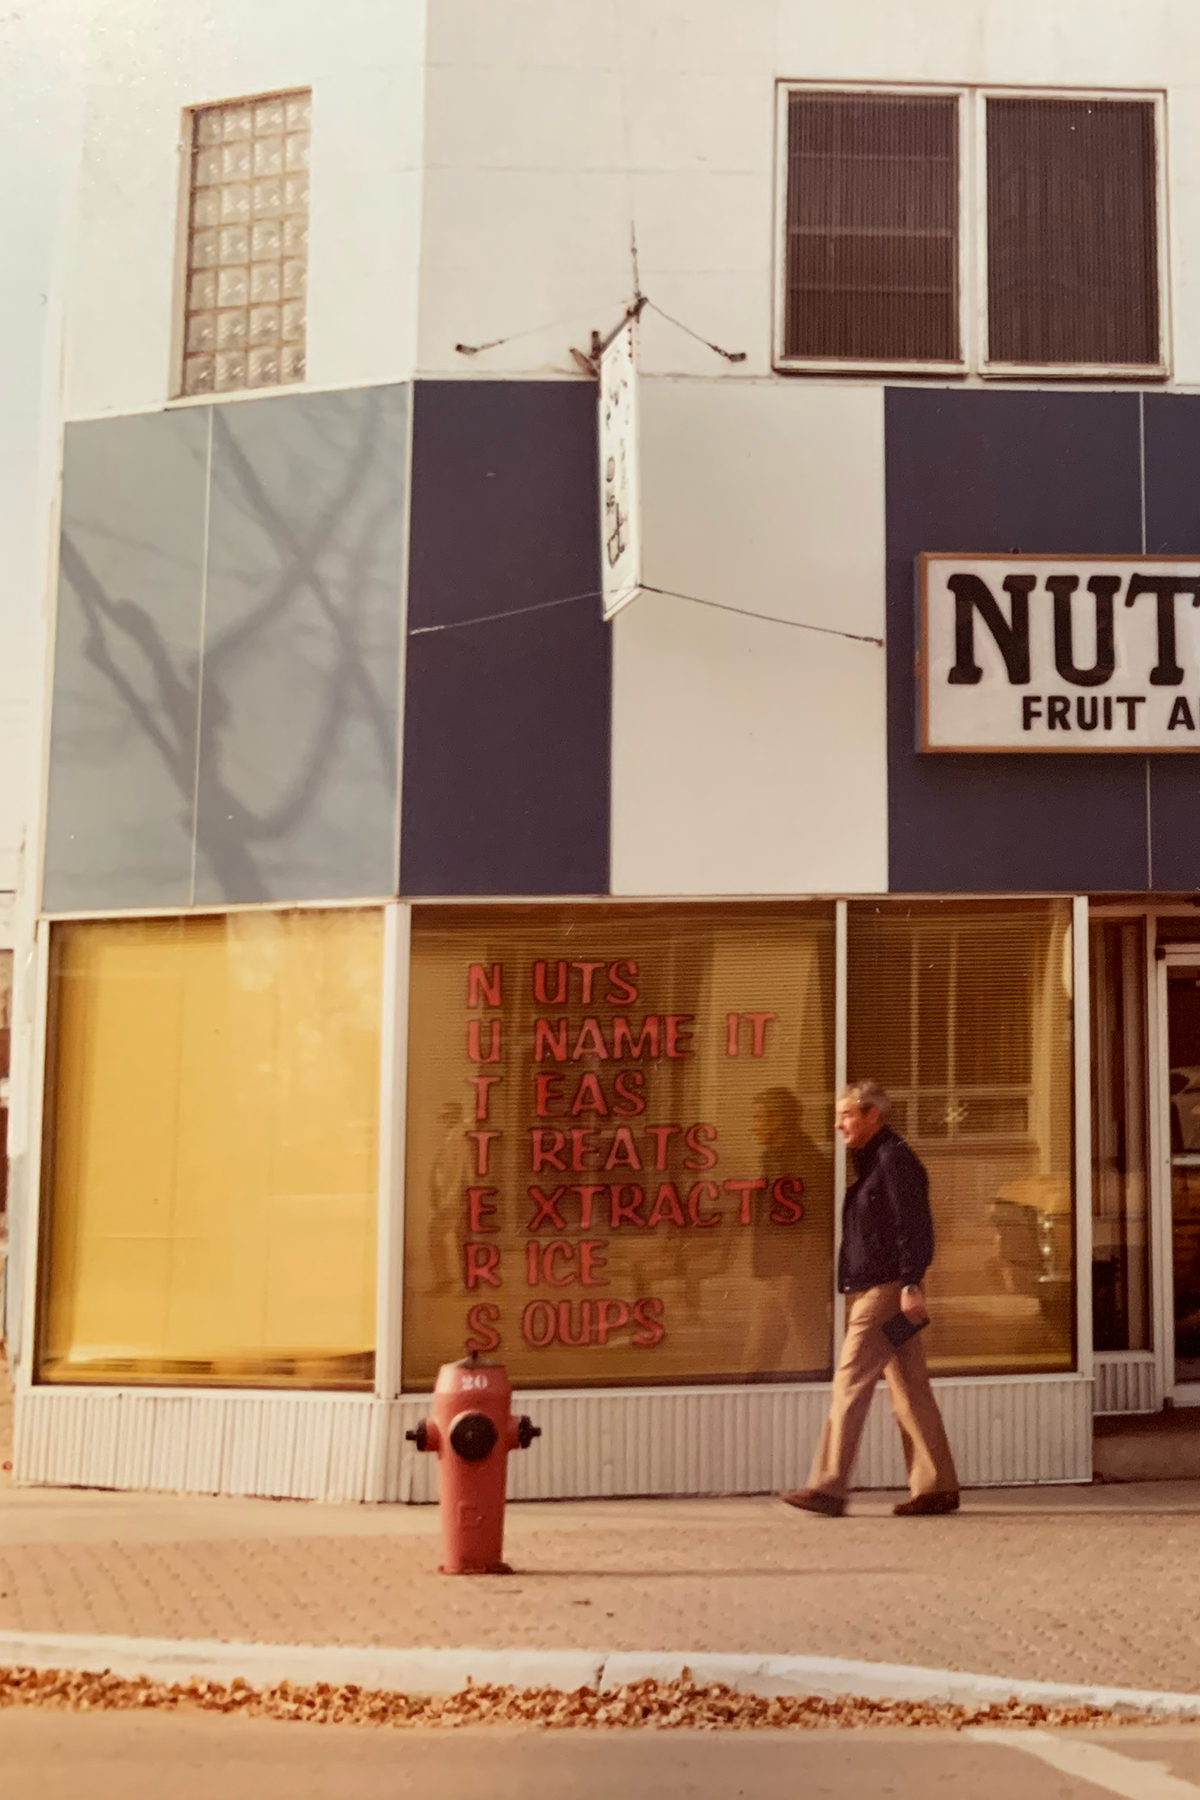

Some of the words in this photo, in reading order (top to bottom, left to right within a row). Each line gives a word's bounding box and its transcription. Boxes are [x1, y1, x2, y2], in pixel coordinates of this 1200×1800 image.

[1021, 695, 1146, 732] FRUIT
[533, 1014, 695, 1062] NAME
[725, 1011, 776, 1057] IT
[462, 1374, 488, 1391] 20
